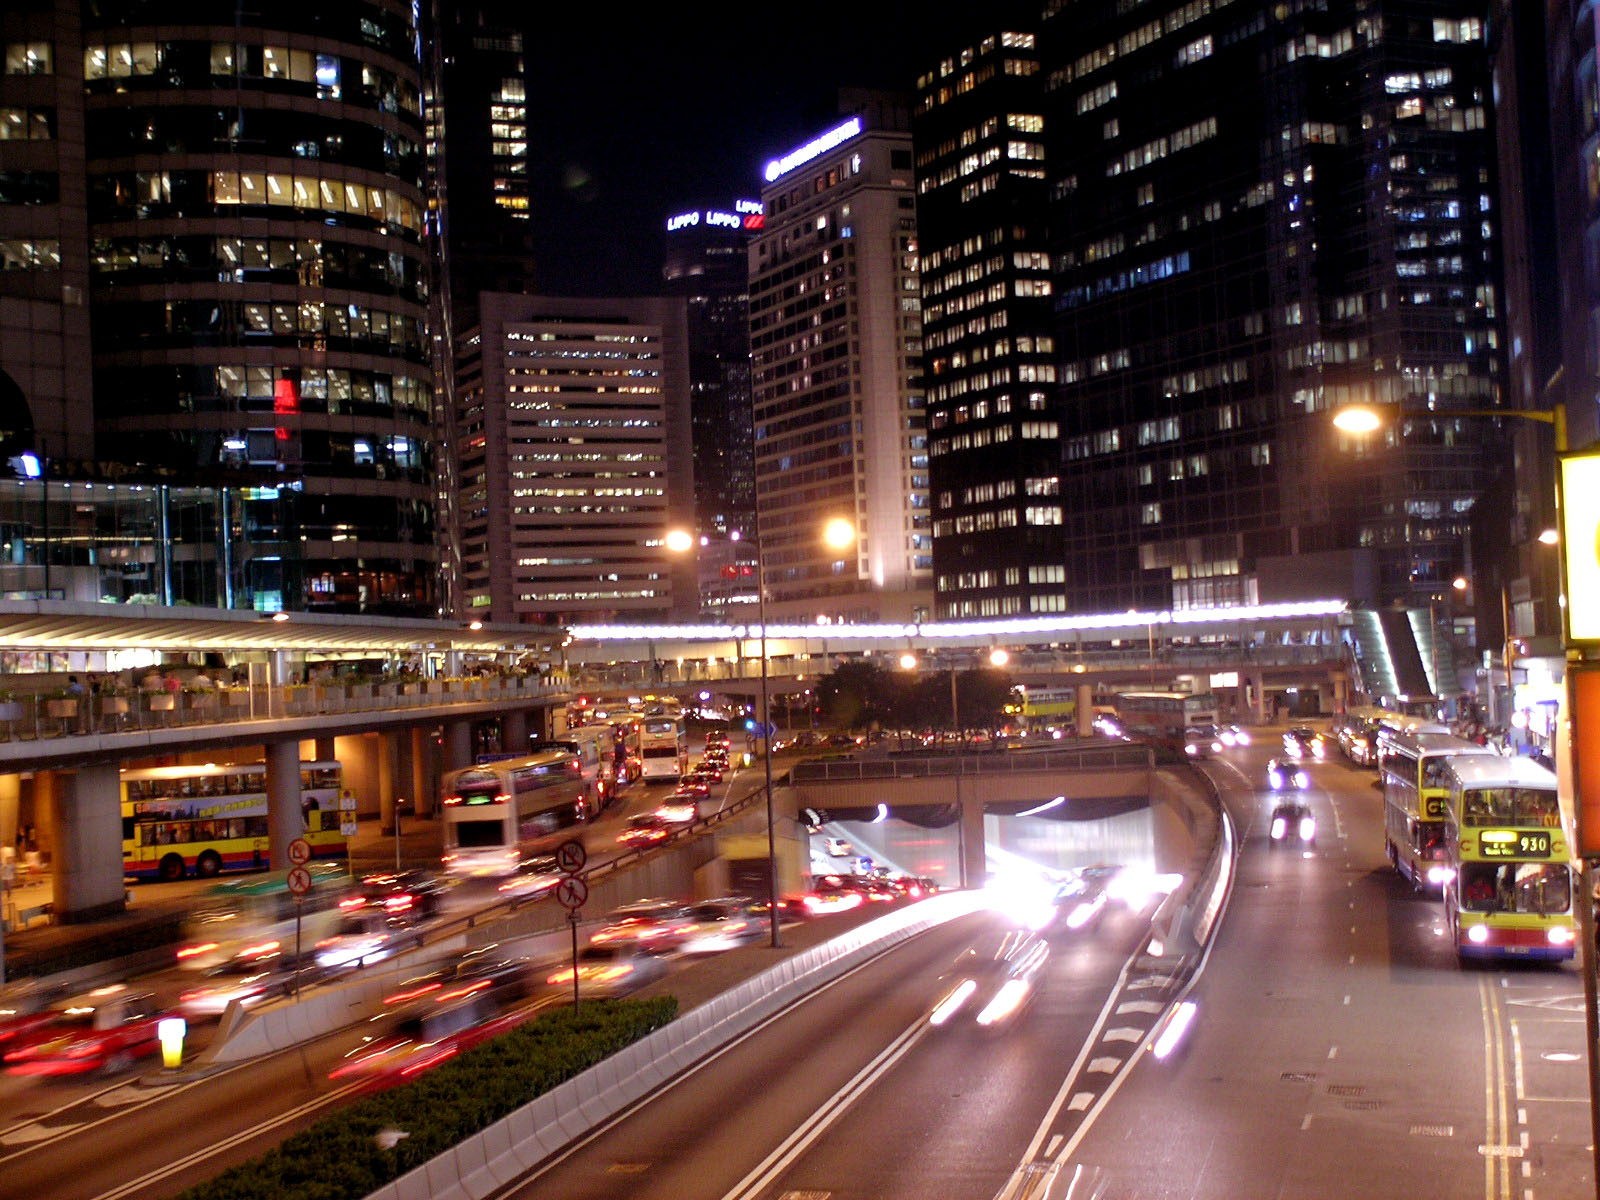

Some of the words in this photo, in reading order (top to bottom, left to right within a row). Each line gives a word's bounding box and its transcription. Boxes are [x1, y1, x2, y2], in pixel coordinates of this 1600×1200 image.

[667, 211, 700, 231] LIPPO
[706, 211, 741, 229] LIPPO
[1520, 837, 1547, 852] 930
